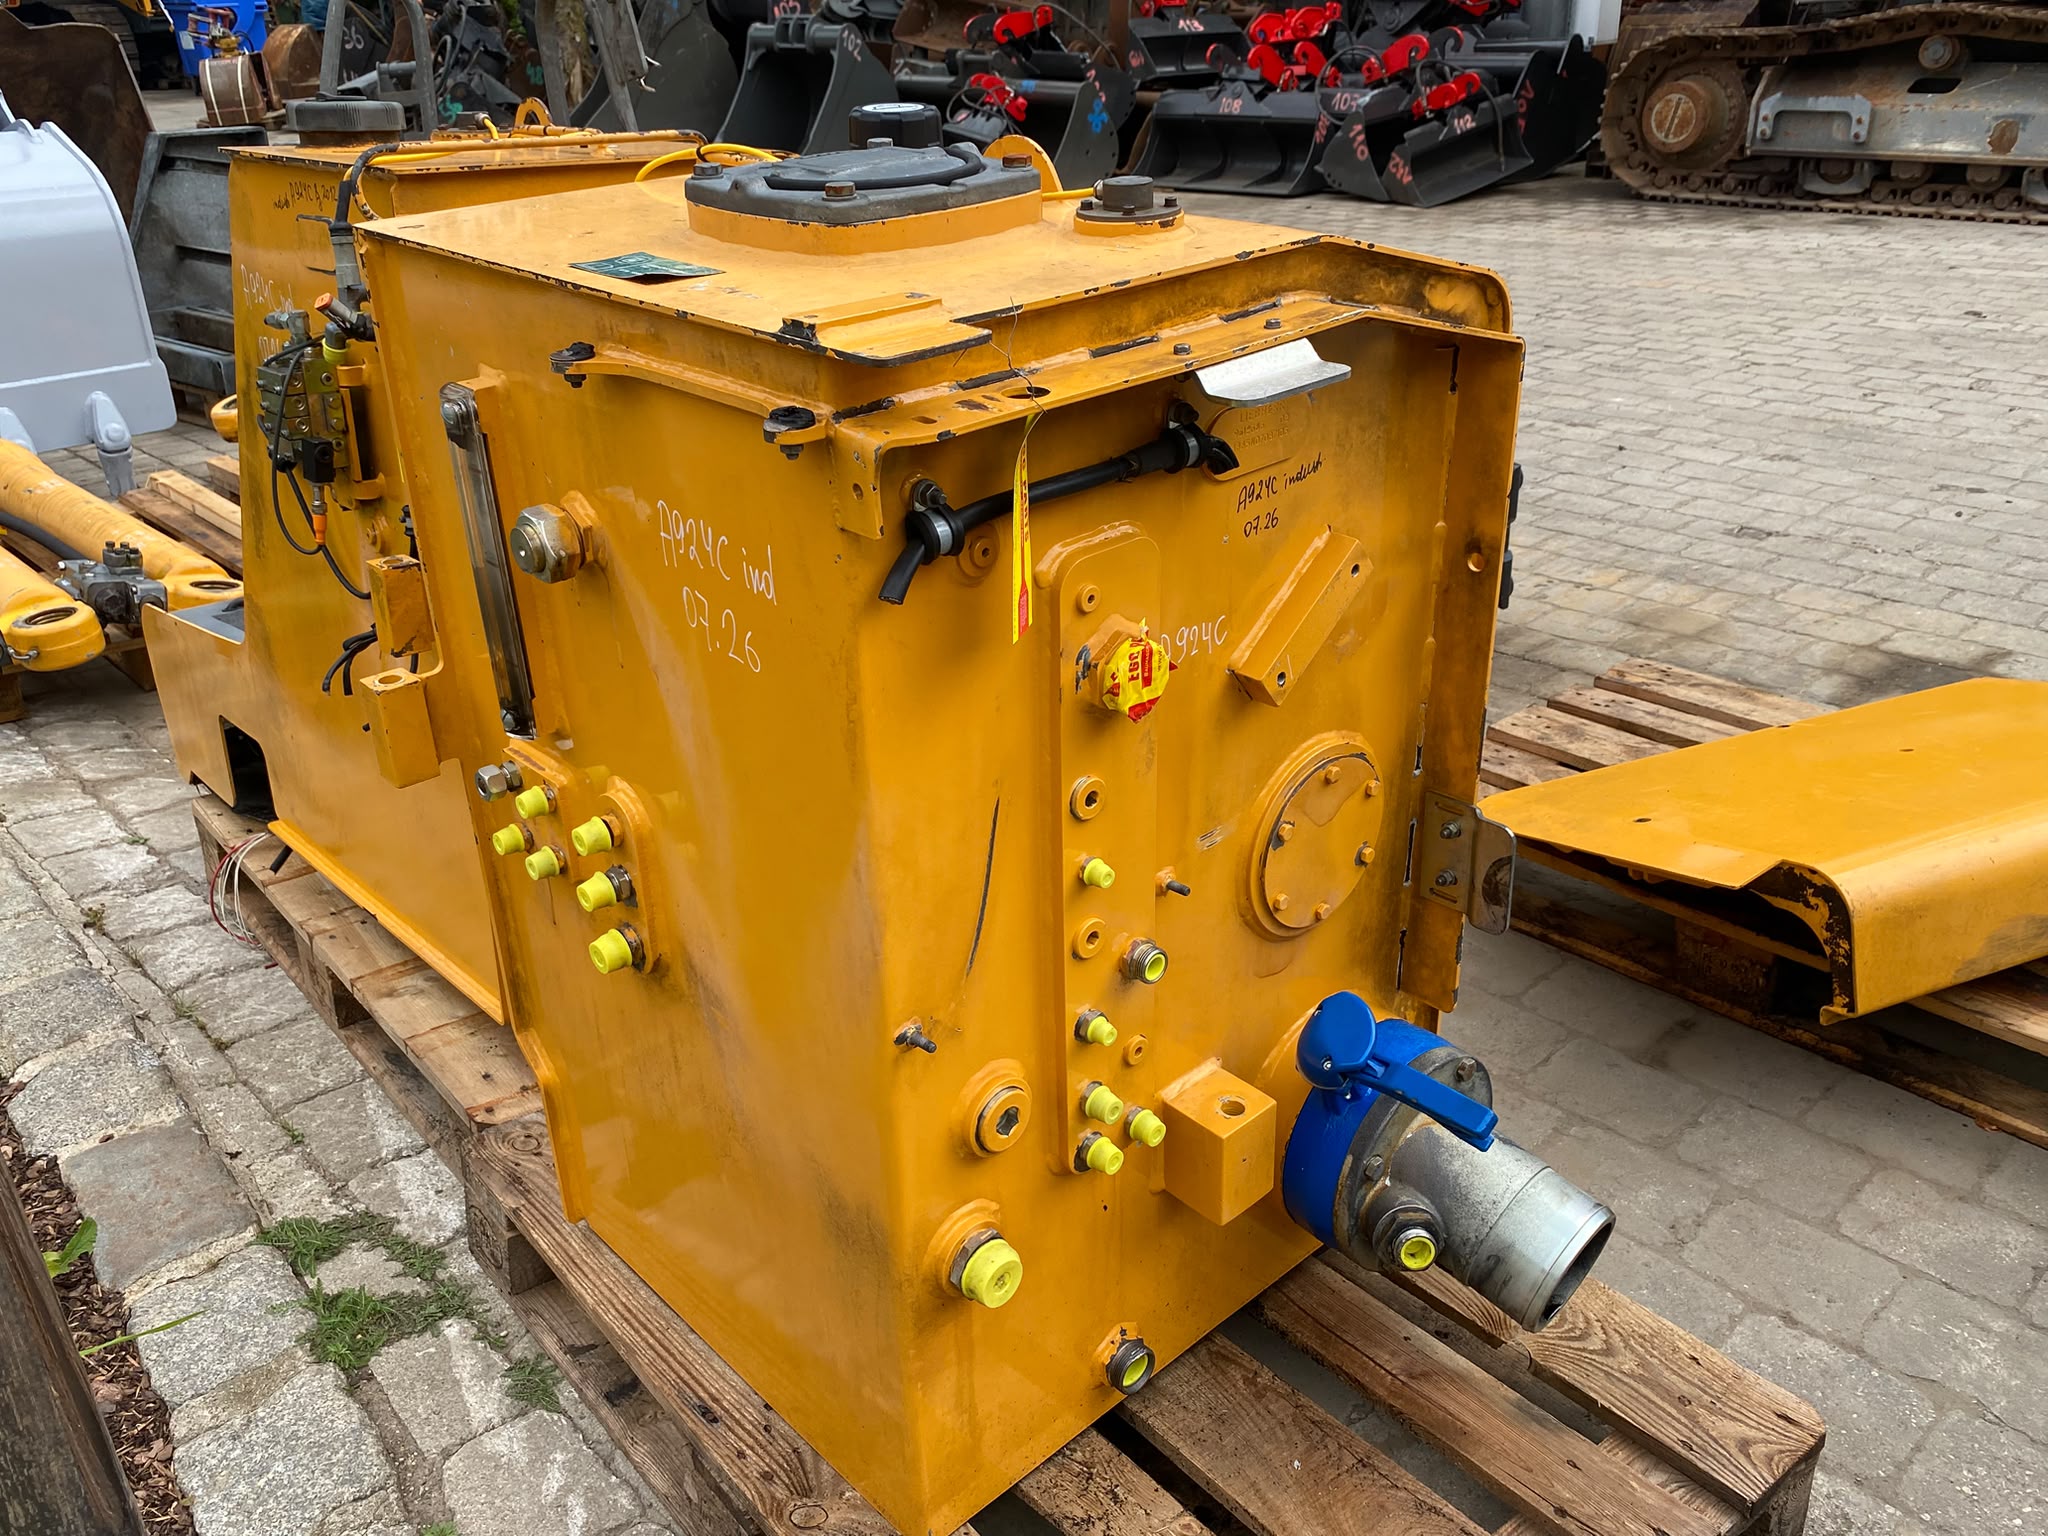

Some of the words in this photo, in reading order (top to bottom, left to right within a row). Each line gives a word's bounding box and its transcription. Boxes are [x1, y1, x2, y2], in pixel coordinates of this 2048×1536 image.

[842, 30, 862, 62] 102
[1219, 96, 1243, 114] 108
[1454, 113, 1476, 135] 112
[1236, 475, 1278, 514] A924C
[1243, 507, 1279, 538] 07.26
[657, 500, 731, 581] A924C
[741, 544, 777, 606] ind
[682, 586, 761, 673] 07.26
